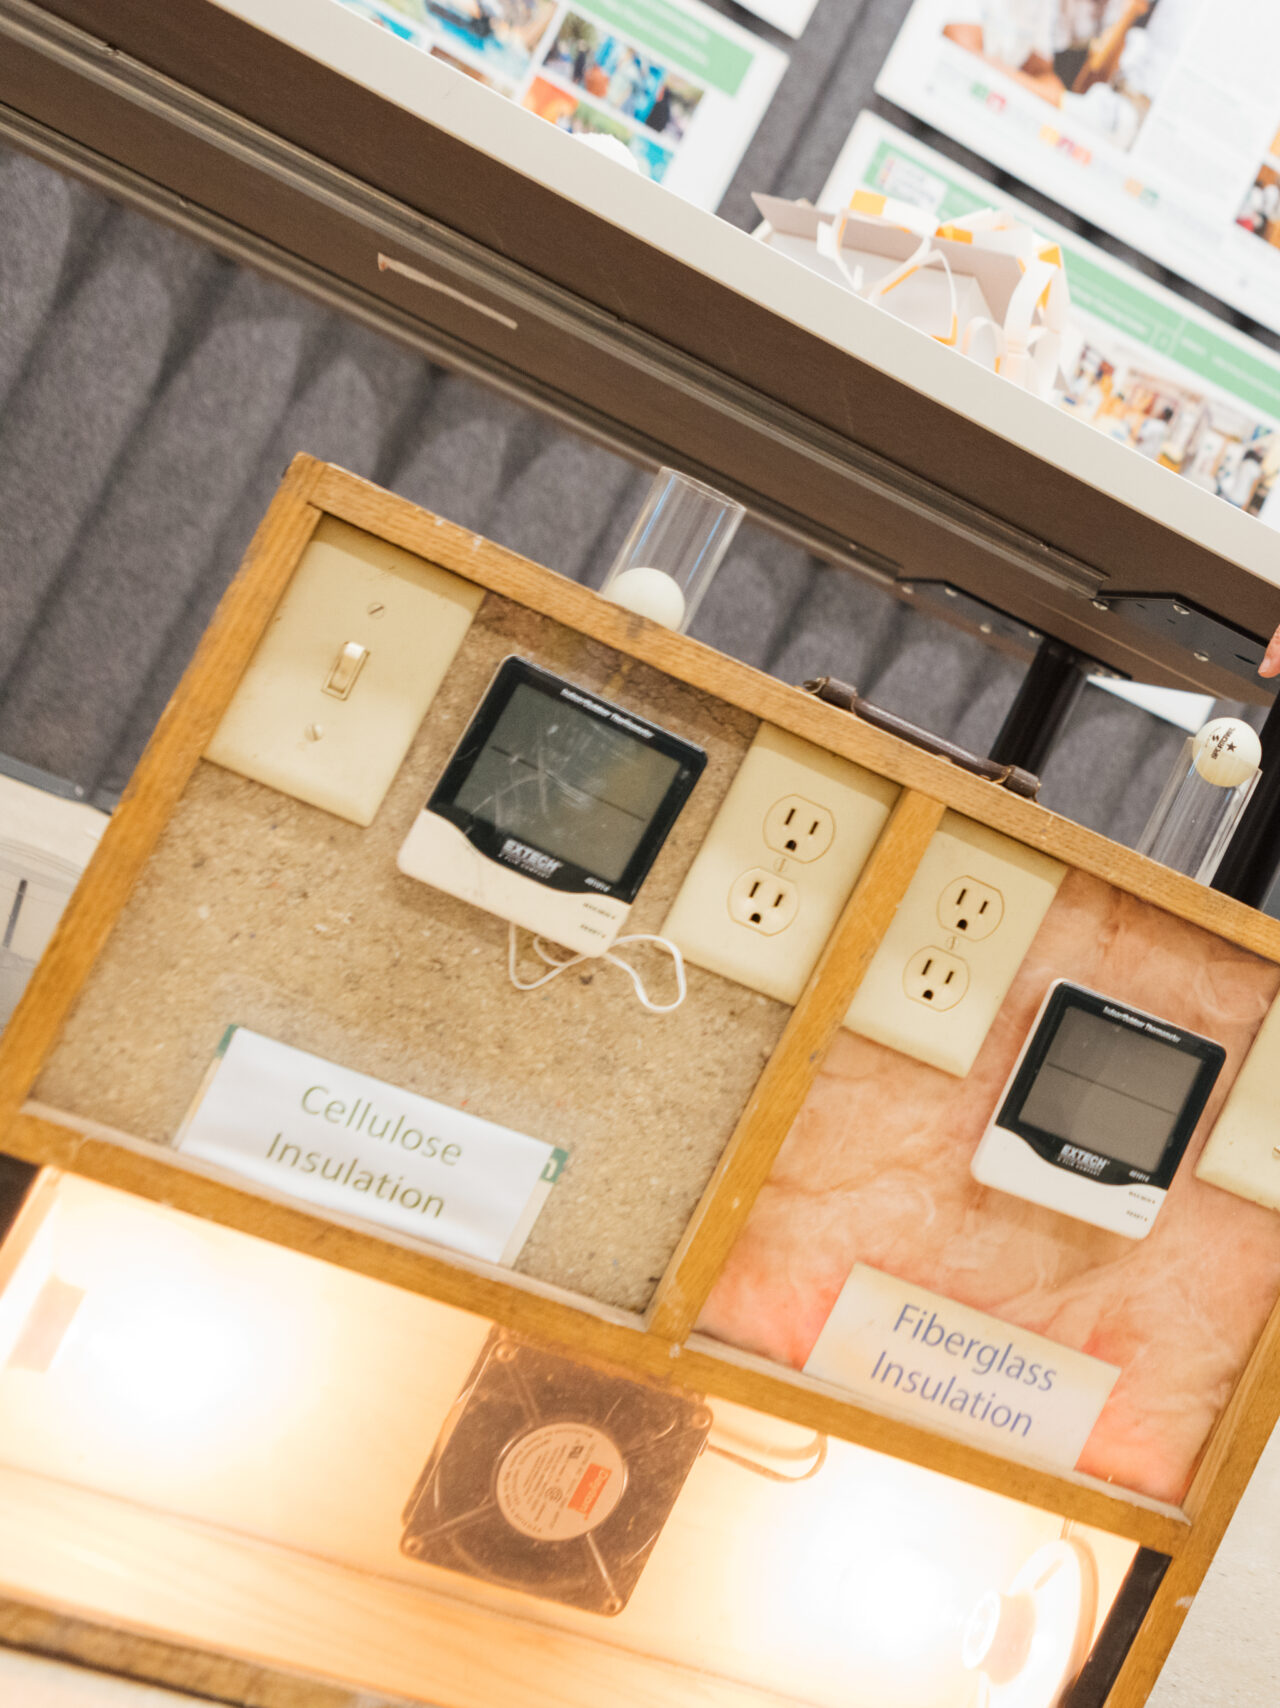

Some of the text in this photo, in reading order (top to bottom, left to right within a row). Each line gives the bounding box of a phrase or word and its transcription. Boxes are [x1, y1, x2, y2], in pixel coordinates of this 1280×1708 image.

[501, 839, 561, 872] EXTECH
[302, 1086, 463, 1166] Cellulose
[1061, 1143, 1107, 1170] EXTECH
[266, 1132, 445, 1219] Insulation
[893, 1303, 1057, 1391] Fiberglass
[871, 1351, 1032, 1437] Insulation
